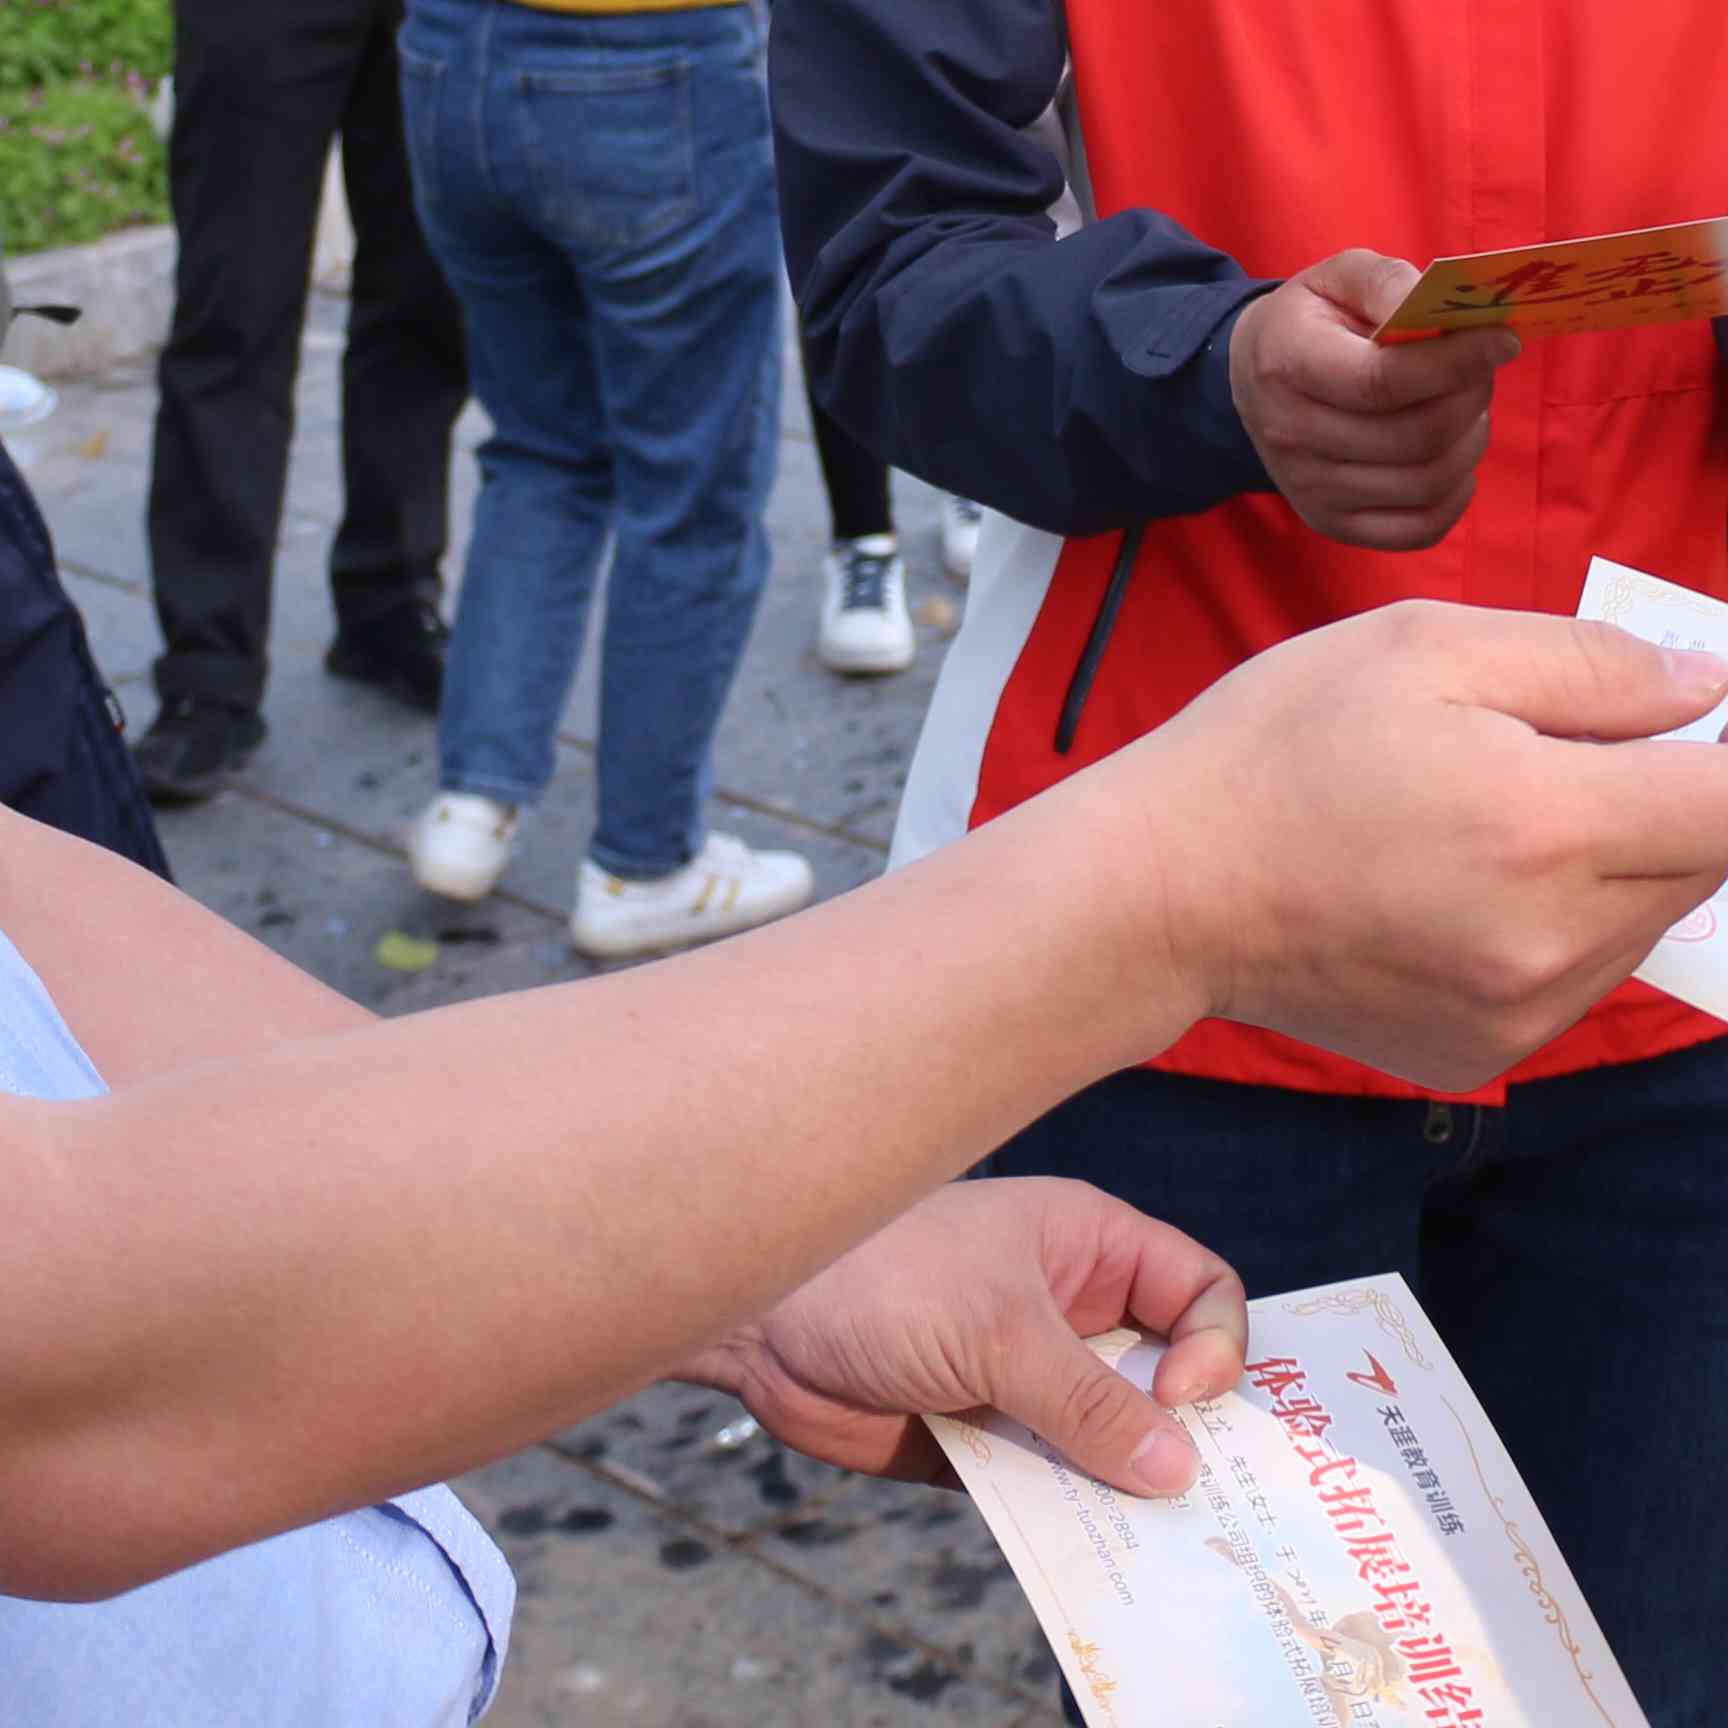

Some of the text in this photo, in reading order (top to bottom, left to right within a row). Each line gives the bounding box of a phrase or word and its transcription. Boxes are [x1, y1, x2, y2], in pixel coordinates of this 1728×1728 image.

[1246, 1355, 1484, 1728] 体验式拓展培训结
[1376, 1404, 1466, 1536] 天涯教育训练
